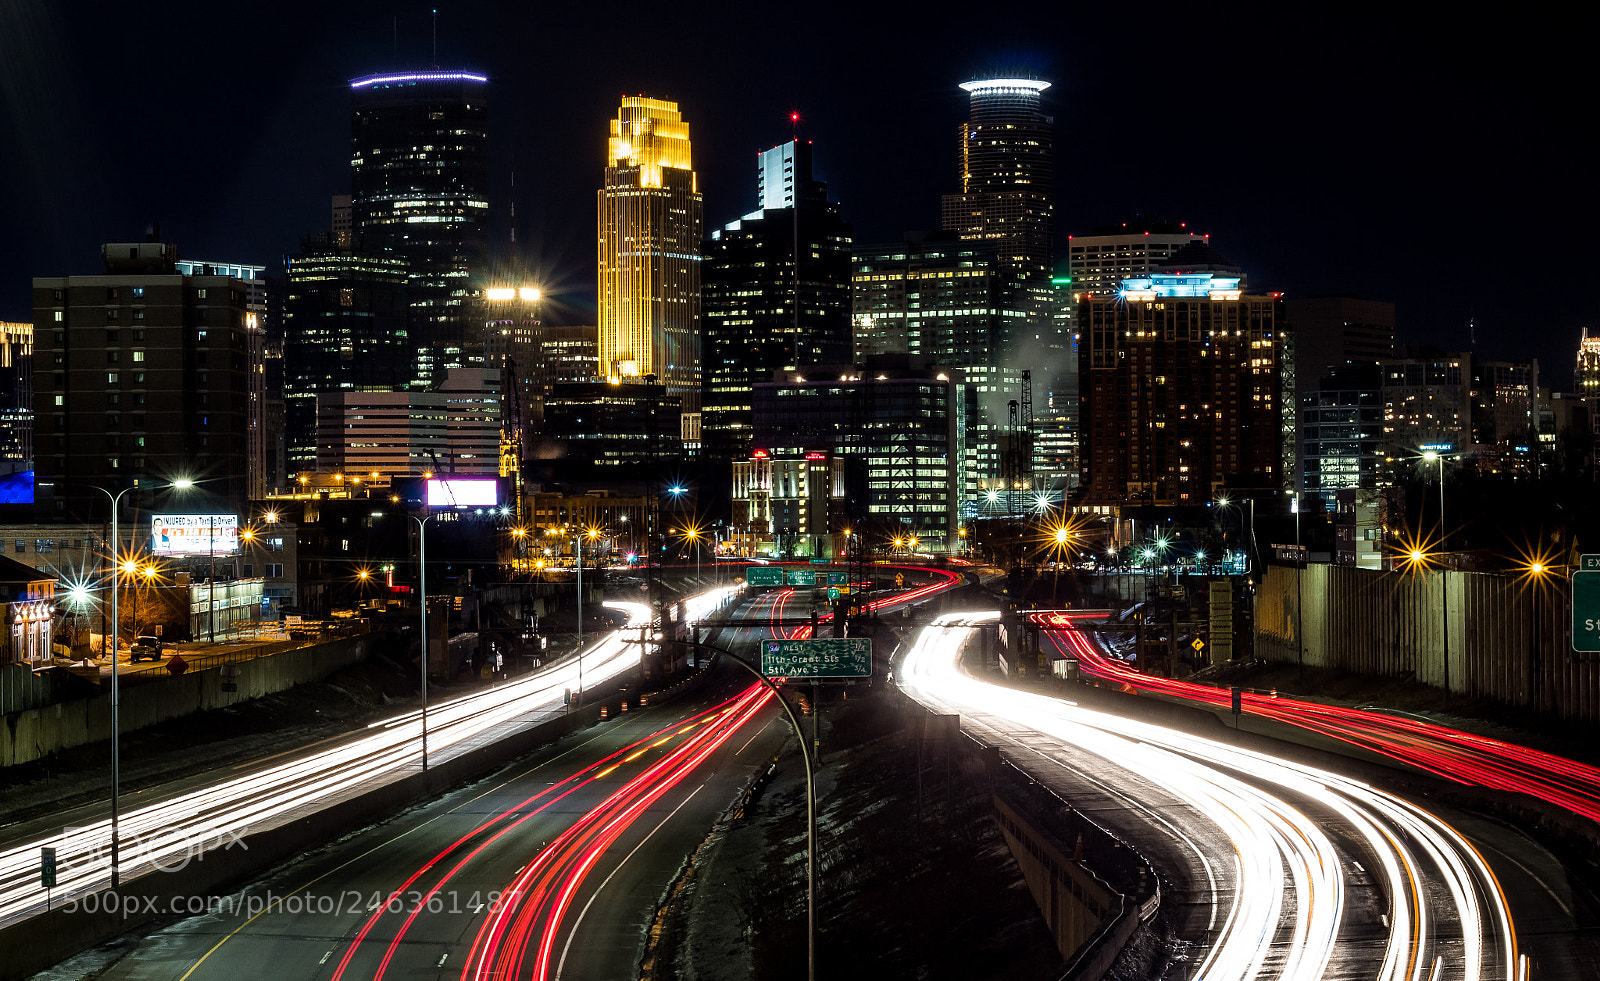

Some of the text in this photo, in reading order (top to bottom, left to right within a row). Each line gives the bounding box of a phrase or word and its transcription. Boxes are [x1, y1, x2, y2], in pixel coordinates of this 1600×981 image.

[163, 516, 186, 526] INJURED
[199, 516, 217, 527] Textig
[769, 645, 780, 653] 94
[768, 655, 819, 664] 11th-Grant
[824, 655, 840, 663] Sts
[768, 666, 785, 674] 5th
[789, 666, 809, 674] Ave
